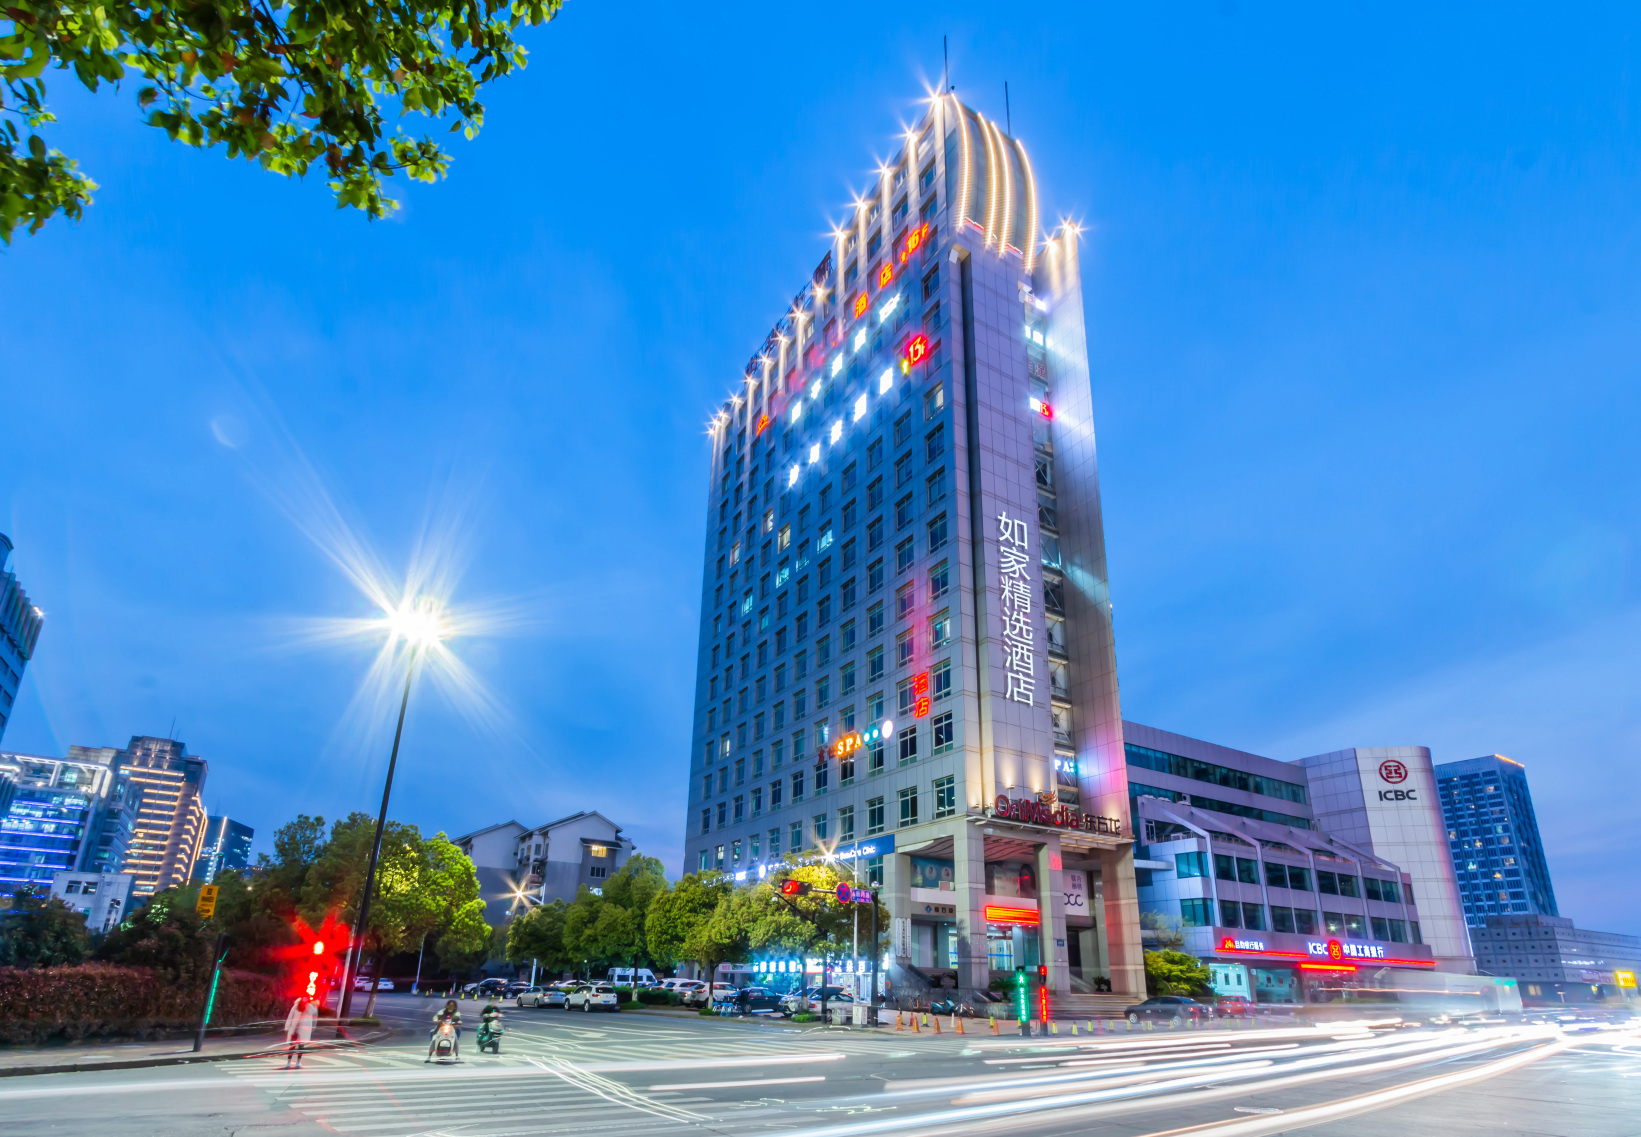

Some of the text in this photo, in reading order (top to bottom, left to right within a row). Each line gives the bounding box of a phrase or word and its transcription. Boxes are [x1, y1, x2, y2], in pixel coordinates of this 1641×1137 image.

[997, 511, 1036, 707] 如家精选酒店
[914, 671, 929, 718] 酒店
[837, 734, 862, 755] SPA
[1378, 789, 1417, 801] ICBC
[995, 794, 1080, 829] OriMedia
[1308, 942, 1384, 958] ICBC 中国工商银行
